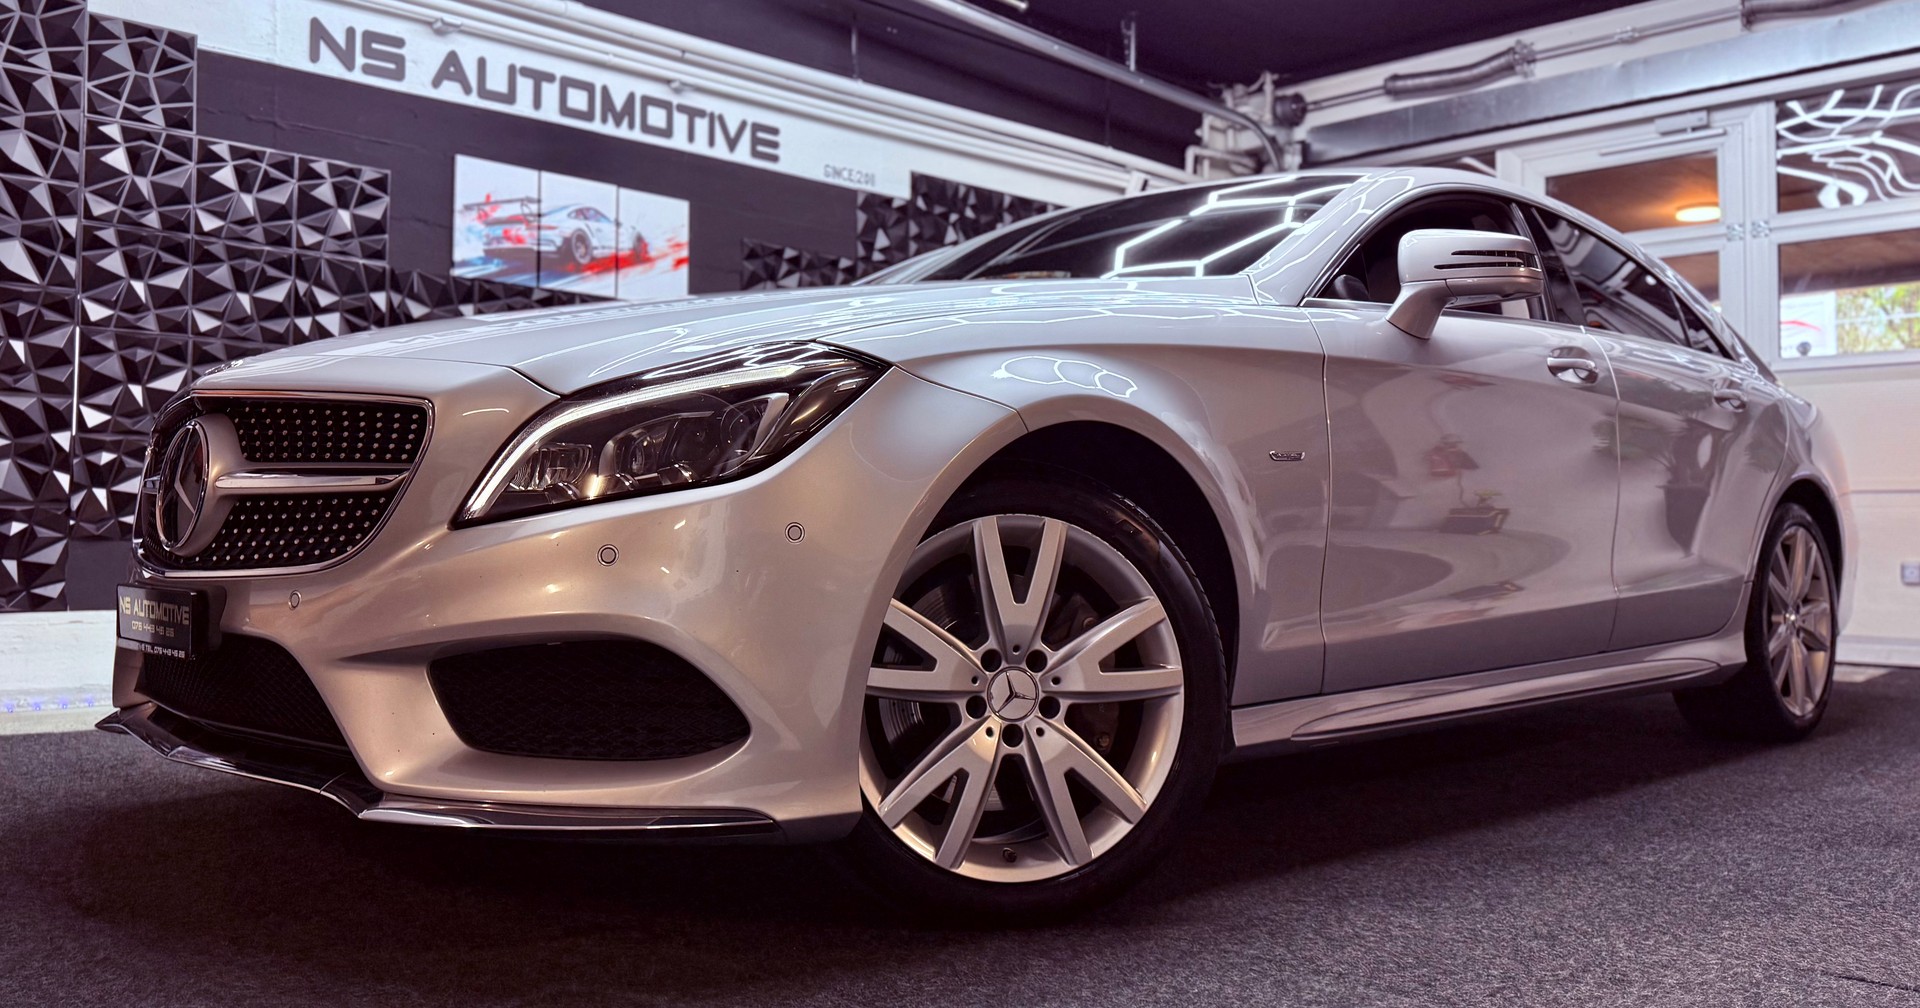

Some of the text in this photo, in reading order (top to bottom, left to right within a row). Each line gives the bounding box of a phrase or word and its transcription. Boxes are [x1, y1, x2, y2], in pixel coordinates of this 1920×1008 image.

[309, 16, 780, 164] NS AUTOMOTIVE
[119, 596, 190, 626] NS AUTOMOTIVE
